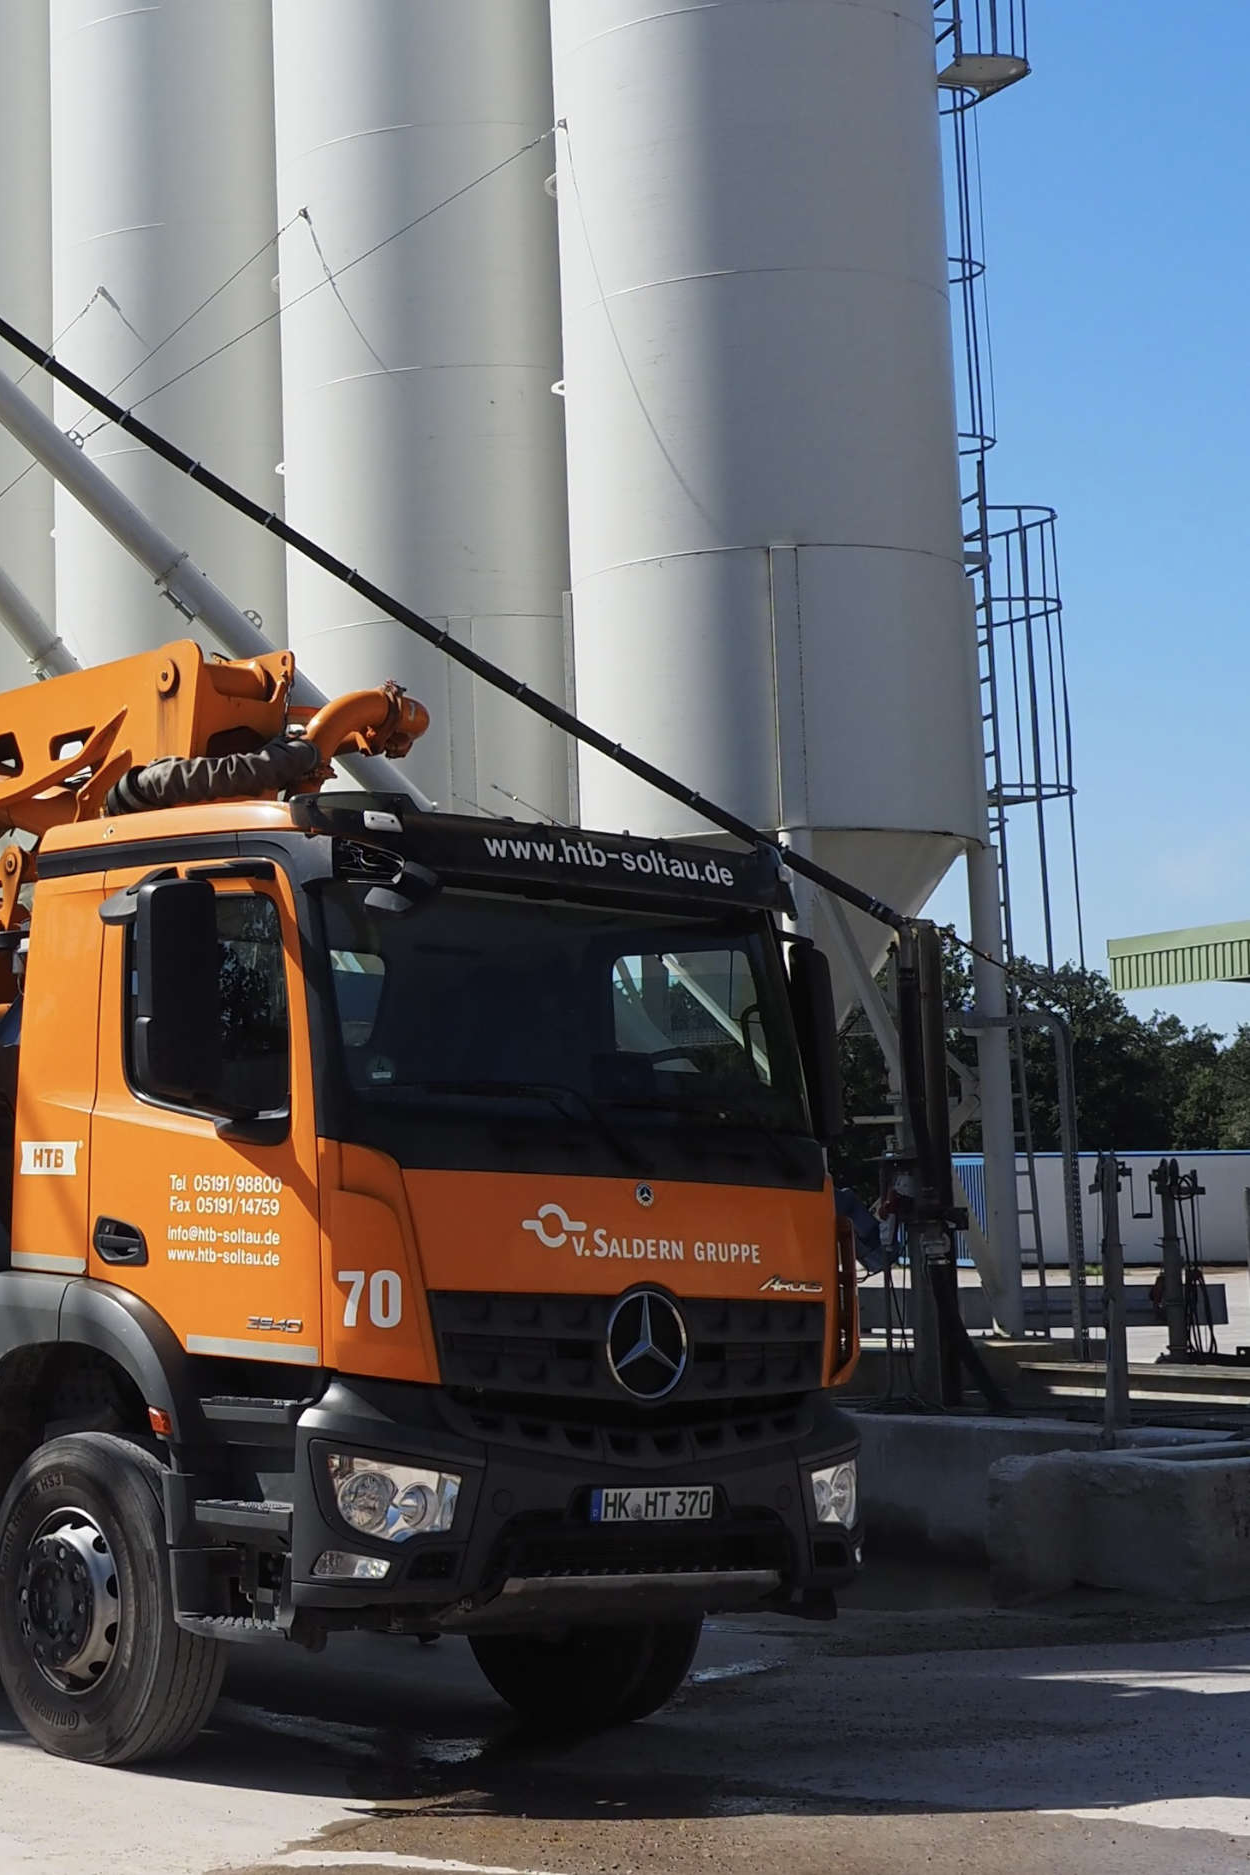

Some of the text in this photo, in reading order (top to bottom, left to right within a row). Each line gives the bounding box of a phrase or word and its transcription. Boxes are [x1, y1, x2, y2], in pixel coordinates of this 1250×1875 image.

[484, 838, 734, 886] www.htb-soltau.de
[33, 1148, 64, 1168] HTB
[170, 1174, 282, 1193] Tel 05191/98800
[170, 1196, 280, 1216] Fax 05191/14759
[168, 1225, 280, 1245] info@htb-soltau.de
[168, 1246, 280, 1266] www.htb-soltau.de
[694, 1241, 760, 1264] GRUPPE
[338, 1270, 402, 1328] 70
[604, 1490, 711, 1518] HK HT 370
